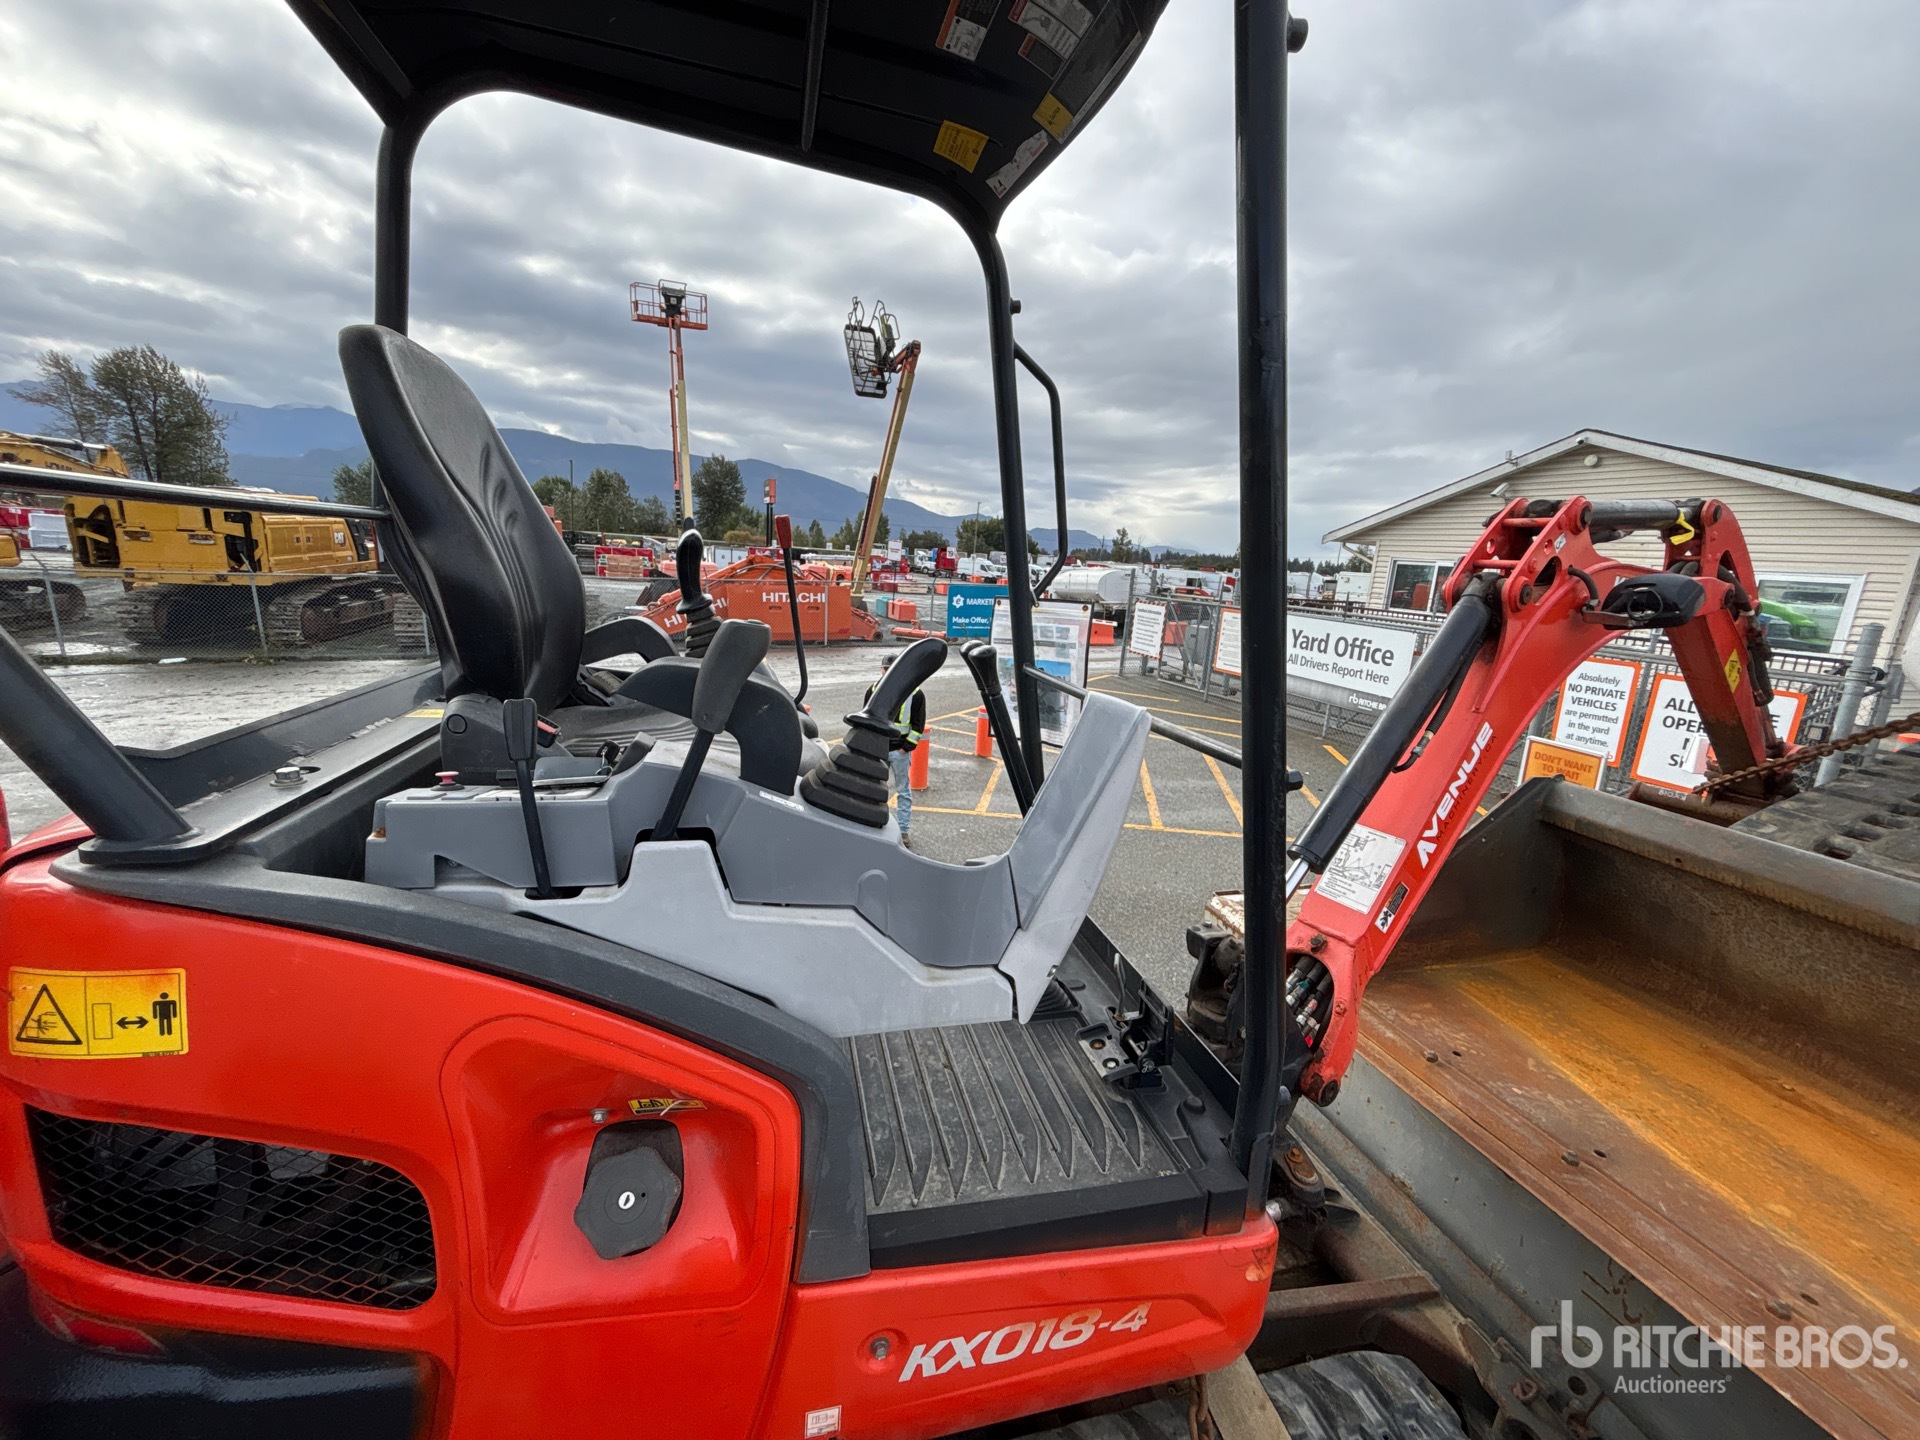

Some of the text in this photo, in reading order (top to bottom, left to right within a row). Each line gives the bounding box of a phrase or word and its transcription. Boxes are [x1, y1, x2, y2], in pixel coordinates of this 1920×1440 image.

[334, 532, 345, 544] CAT
[952, 616, 989, 625] Make Offer,
[1292, 629, 1394, 667] Yard Office
[1288, 653, 1390, 685] All Drivers Report Here
[1578, 672, 1621, 687] Absolutely
[1568, 683, 1626, 700] NO PRIVATE
[1358, 698, 1378, 709] RITCHIE
[1571, 696, 1618, 712] VEHICLES
[1564, 709, 1618, 724] are permitted
[1568, 720, 1610, 736] in the yard
[1565, 732, 1609, 748] at anytime.
[1534, 751, 1593, 774] DON'T WANT
[1541, 763, 1581, 781] TO WAIT
[1416, 721, 1493, 869] AVENUE
[898, 1302, 1152, 1383] KX018-4
